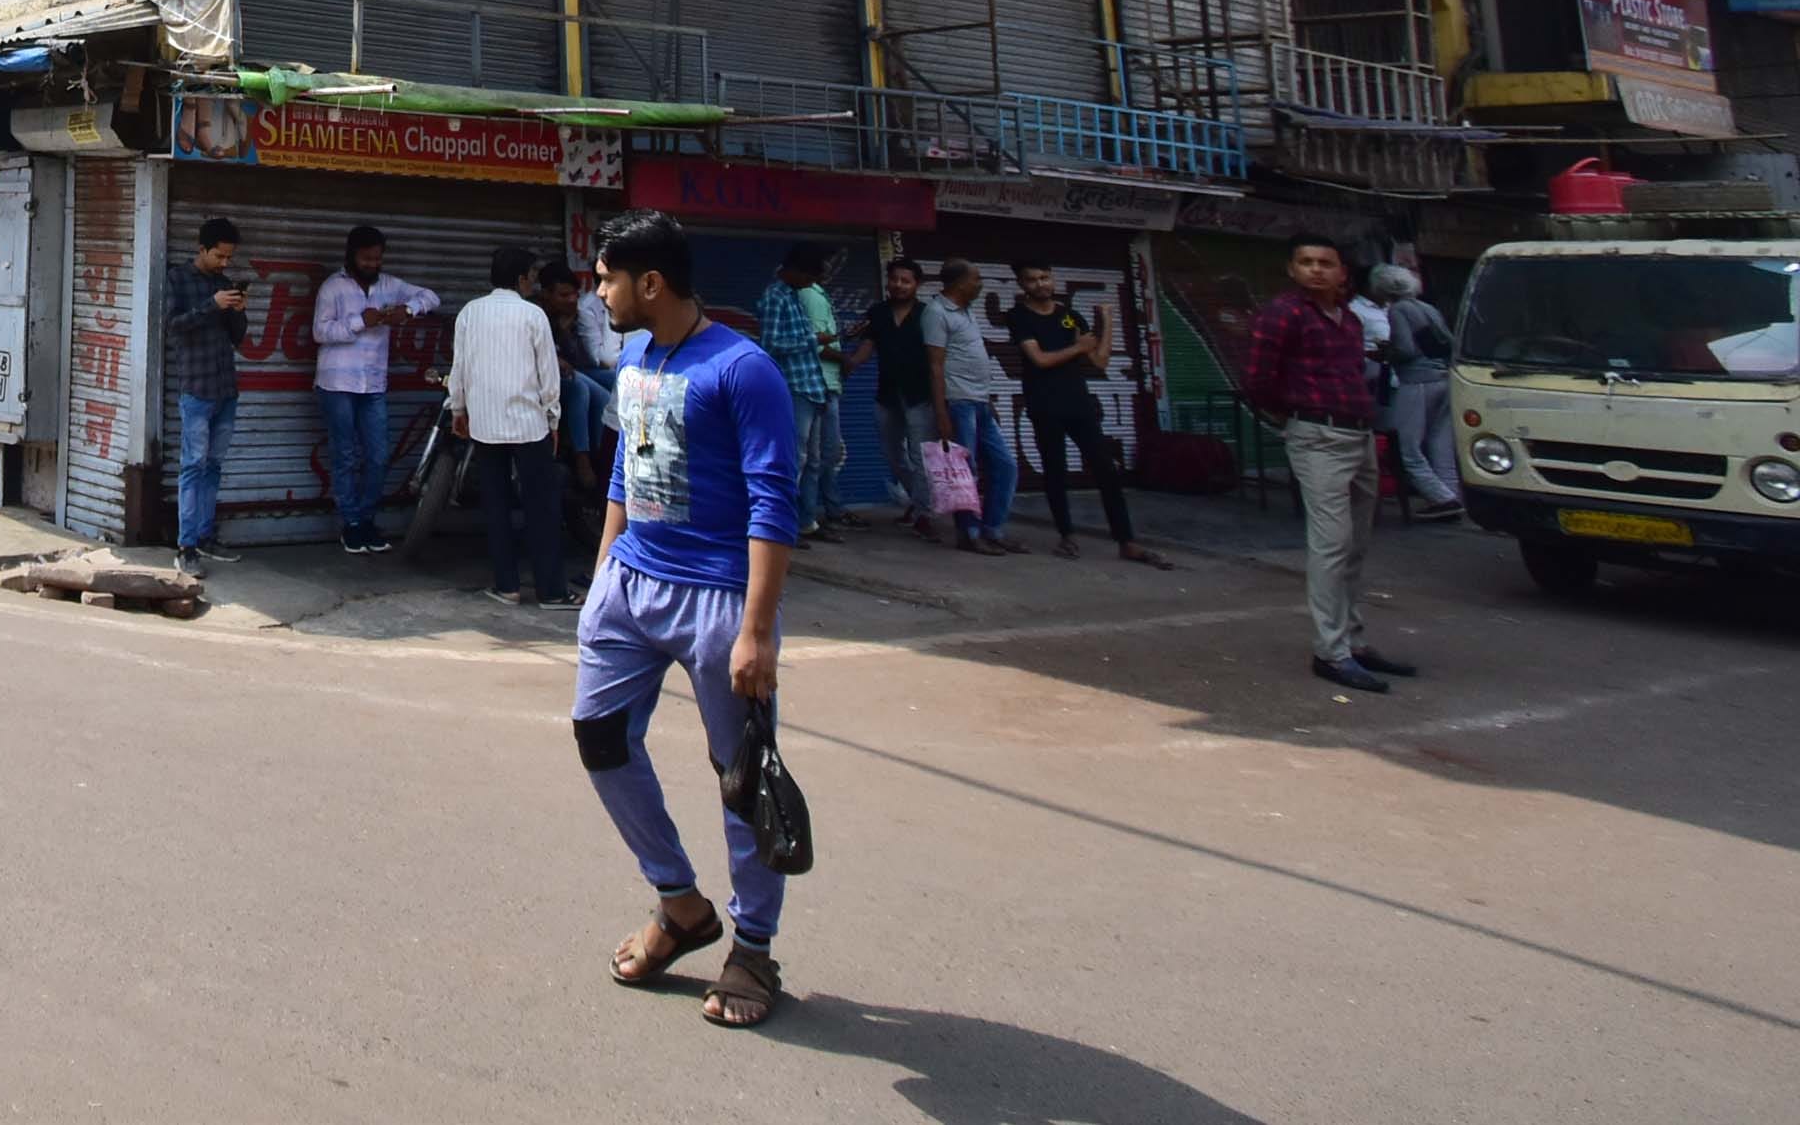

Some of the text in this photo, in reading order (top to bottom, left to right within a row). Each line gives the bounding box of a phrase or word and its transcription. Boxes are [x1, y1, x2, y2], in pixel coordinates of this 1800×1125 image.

[258, 104, 399, 156] SHAMEENA
[404, 126, 487, 161] Chappal
[493, 134, 559, 163] Corner
